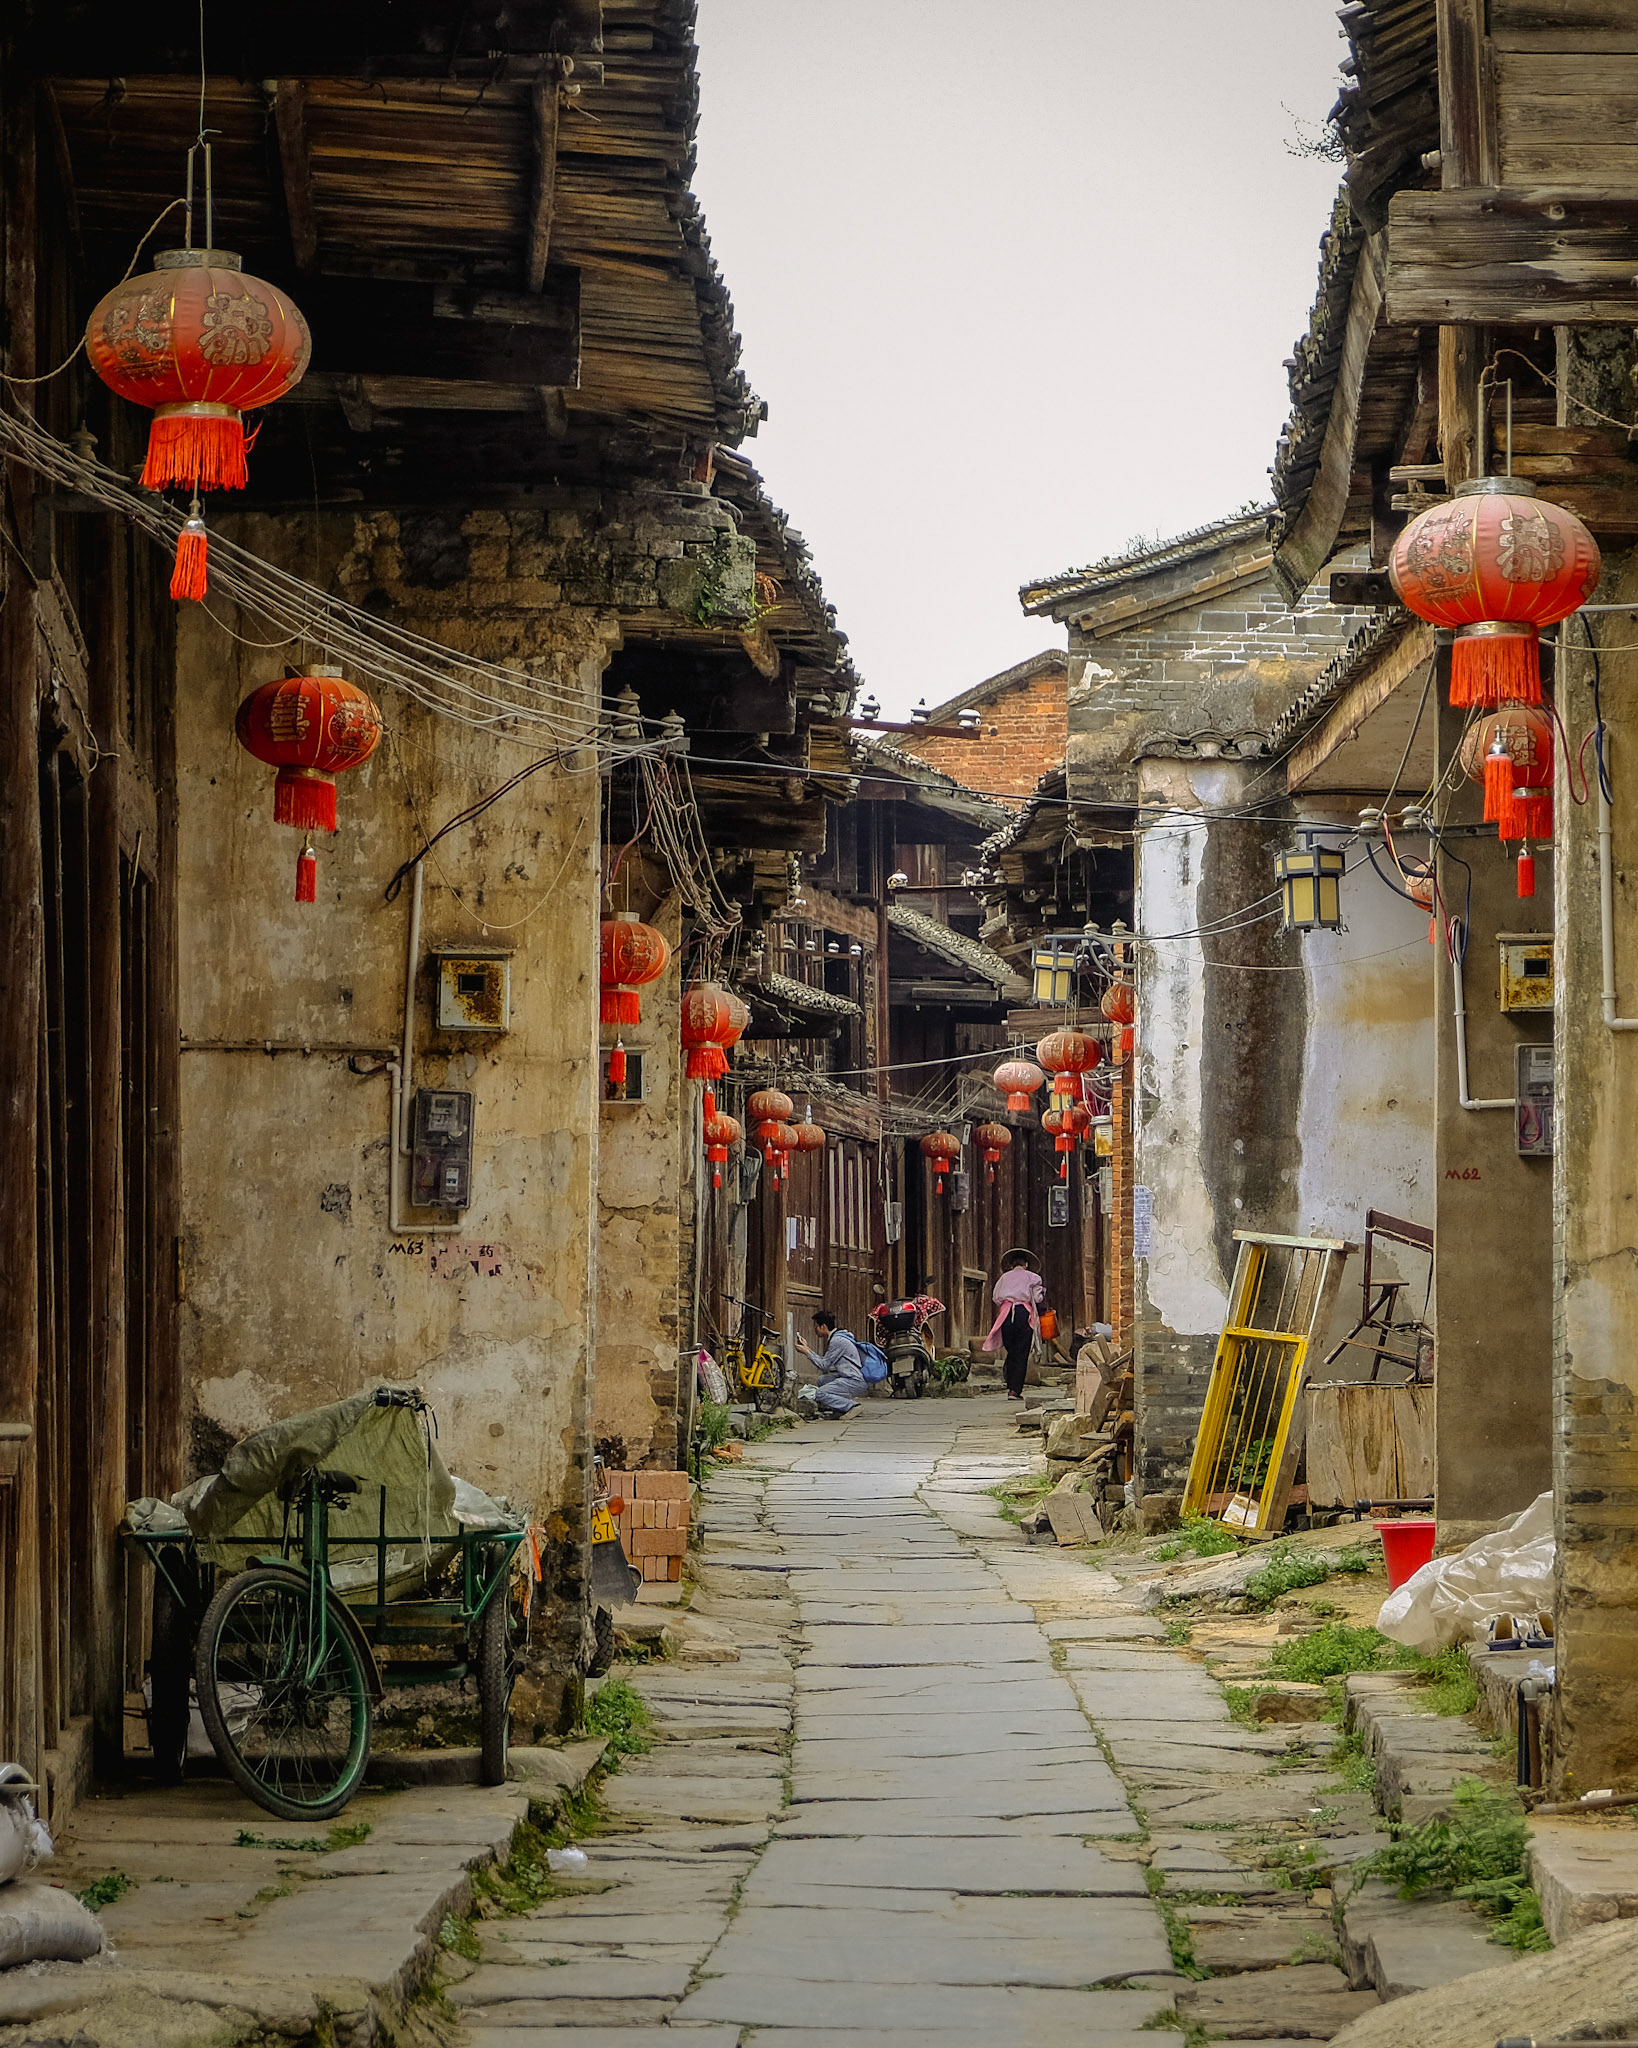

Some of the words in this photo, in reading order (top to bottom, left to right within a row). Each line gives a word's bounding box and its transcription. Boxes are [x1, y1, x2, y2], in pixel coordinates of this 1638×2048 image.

[1445, 1167, 1481, 1180] M62
[388, 1238, 424, 1256] M63
[478, 1245, 495, 1258] 药
